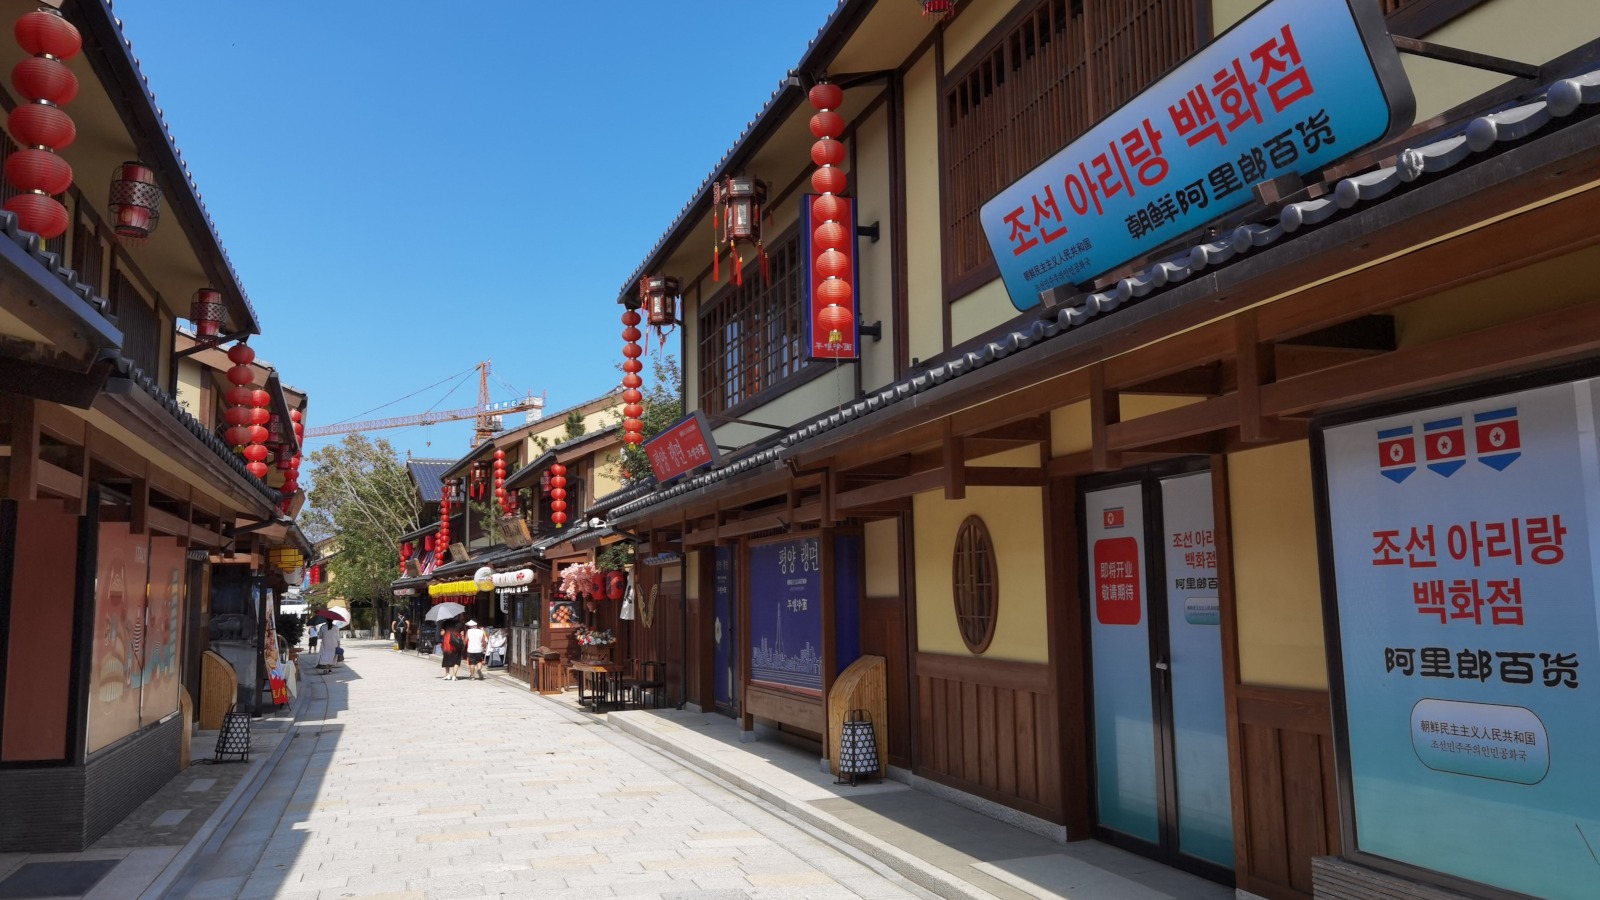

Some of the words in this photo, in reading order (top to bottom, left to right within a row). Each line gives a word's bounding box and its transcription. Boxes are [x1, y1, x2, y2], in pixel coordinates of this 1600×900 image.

[1003, 184, 1068, 257] 조선
[1064, 118, 1169, 216] 아리랑
[1167, 24, 1315, 147] 백화점
[1124, 108, 1336, 240] 朝鲜阿里郎百货
[1023, 237, 1092, 281] 朝鲜民主主义人民共和国
[1173, 531, 1193, 548] 조선
[1372, 524, 1437, 568] 조선
[1447, 514, 1567, 567] 아리랑
[778, 545, 797, 575] 평양
[1100, 561, 1134, 579] 即将开业
[1185, 550, 1217, 569] 백화점
[1101, 583, 1134, 601] 敬请期待
[1412, 577, 1524, 625] 백화점
[1384, 646, 1579, 689] 阿里郎百货
[1420, 720, 1536, 746] 朝鲜民主主义人民共和国
[1430, 739, 1528, 763] 조선민주주의인민공화국
